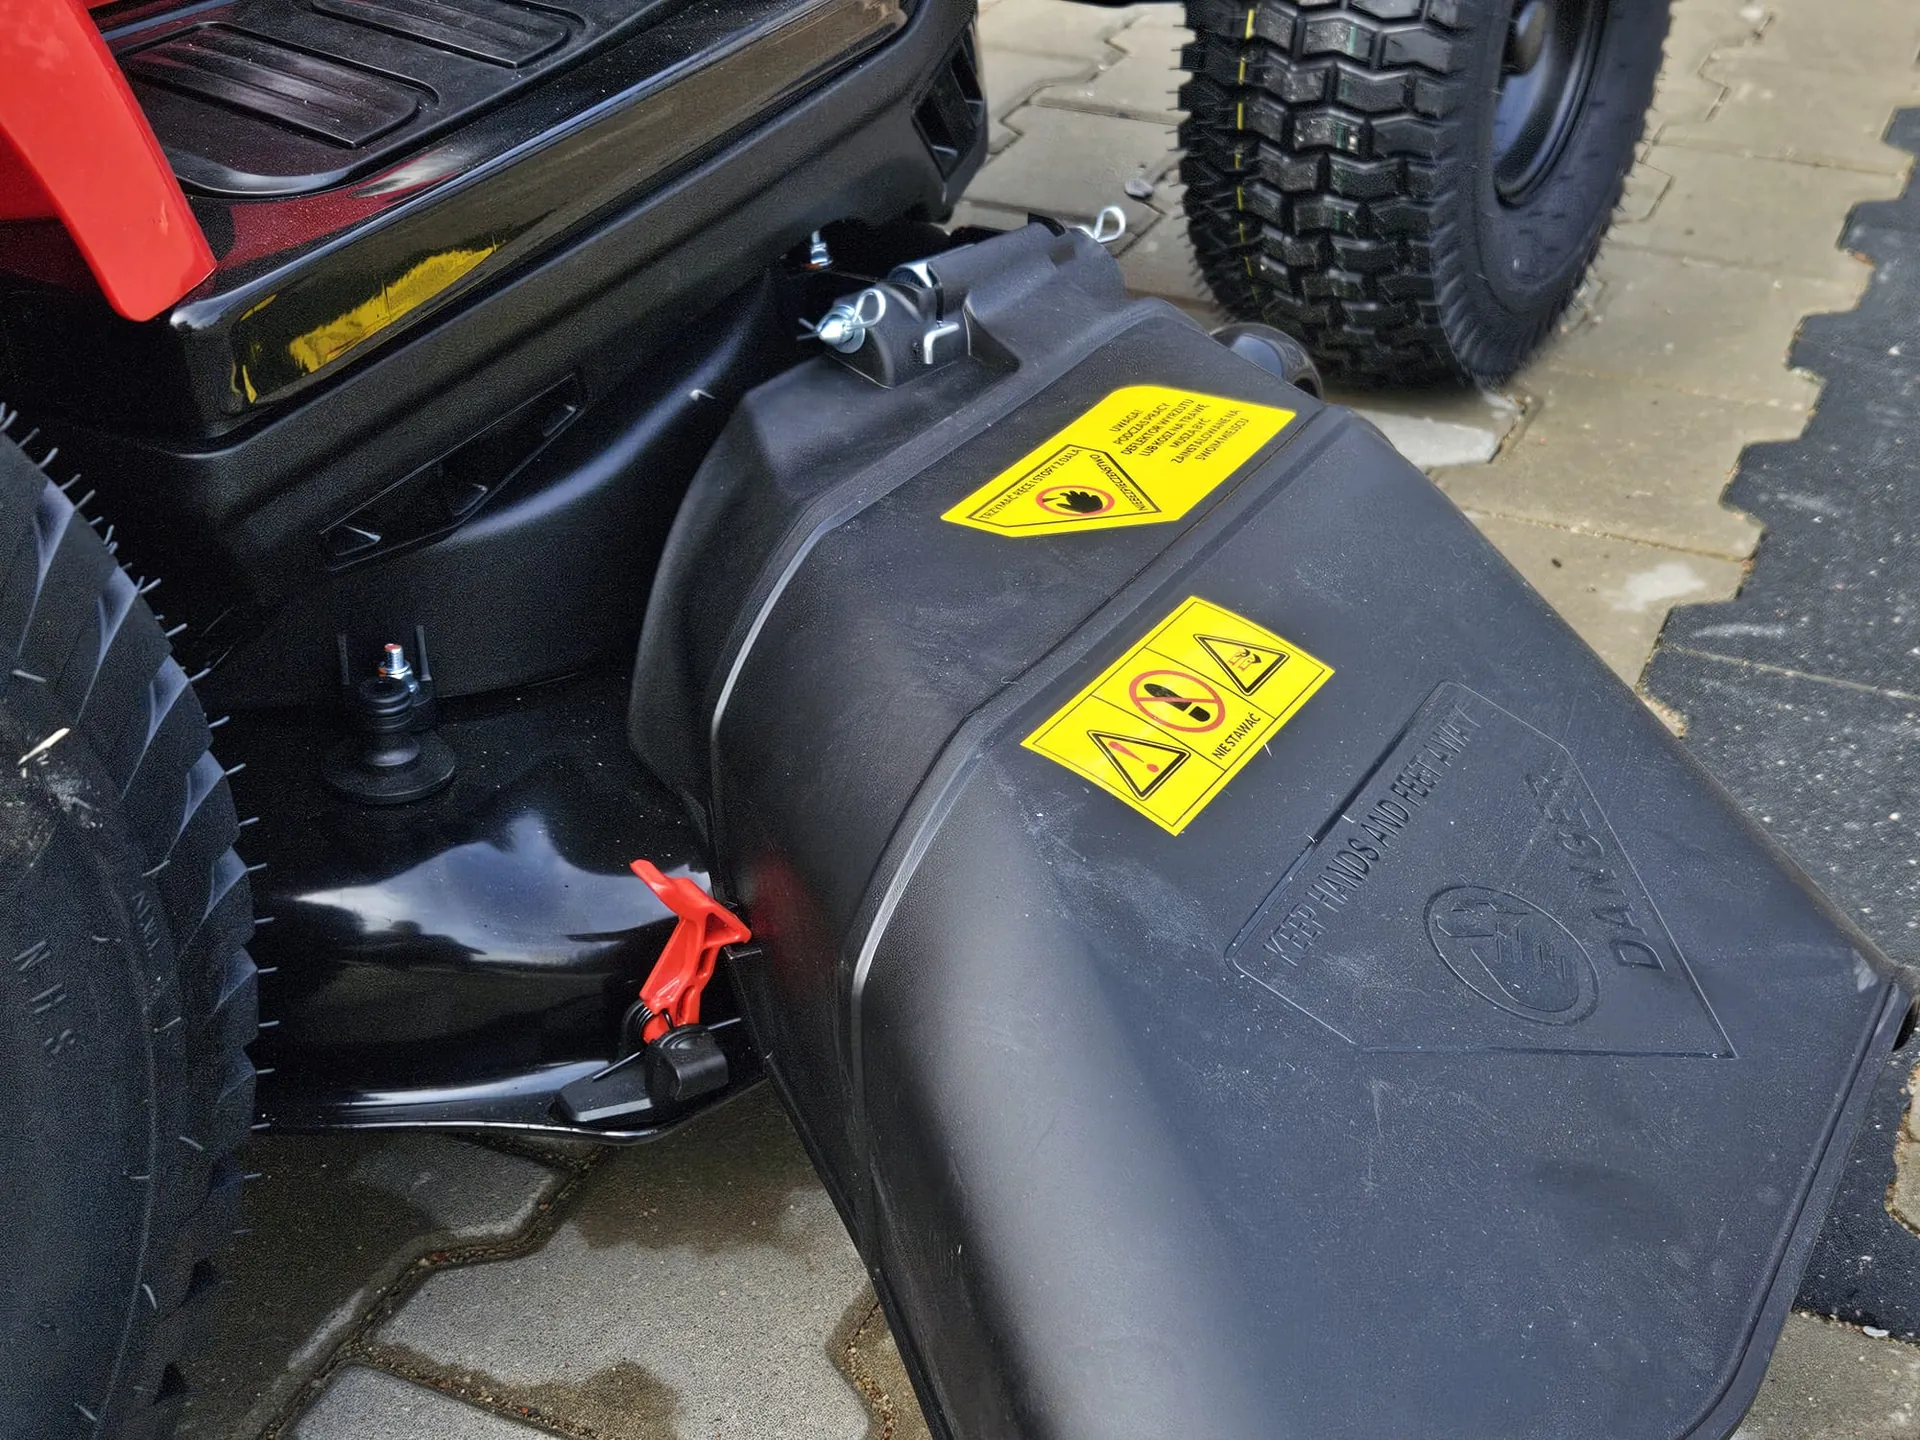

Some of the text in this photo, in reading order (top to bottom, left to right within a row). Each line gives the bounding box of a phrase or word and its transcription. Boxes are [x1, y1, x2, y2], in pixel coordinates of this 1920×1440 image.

[1113, 402, 1170, 445] PODCZAS PRACY
[1120, 398, 1194, 455] DEFLEKTOR WYRZUTU
[1139, 445, 1158, 456] LUB
[1151, 430, 1176, 446] KOSZ
[1170, 417, 1231, 464] ZAINSTALOWANE
[1195, 418, 1249, 460] SWOIM MIEJSCU
[979, 492, 1019, 519] TRZYMAĆ
[1033, 465, 1058, 481] STOPY
[1060, 449, 1082, 463] DALA
[1212, 712, 1262, 760] NIE STAWAĆ
[1263, 704, 1482, 967] KEEP HANDS AND FEET AWAY
